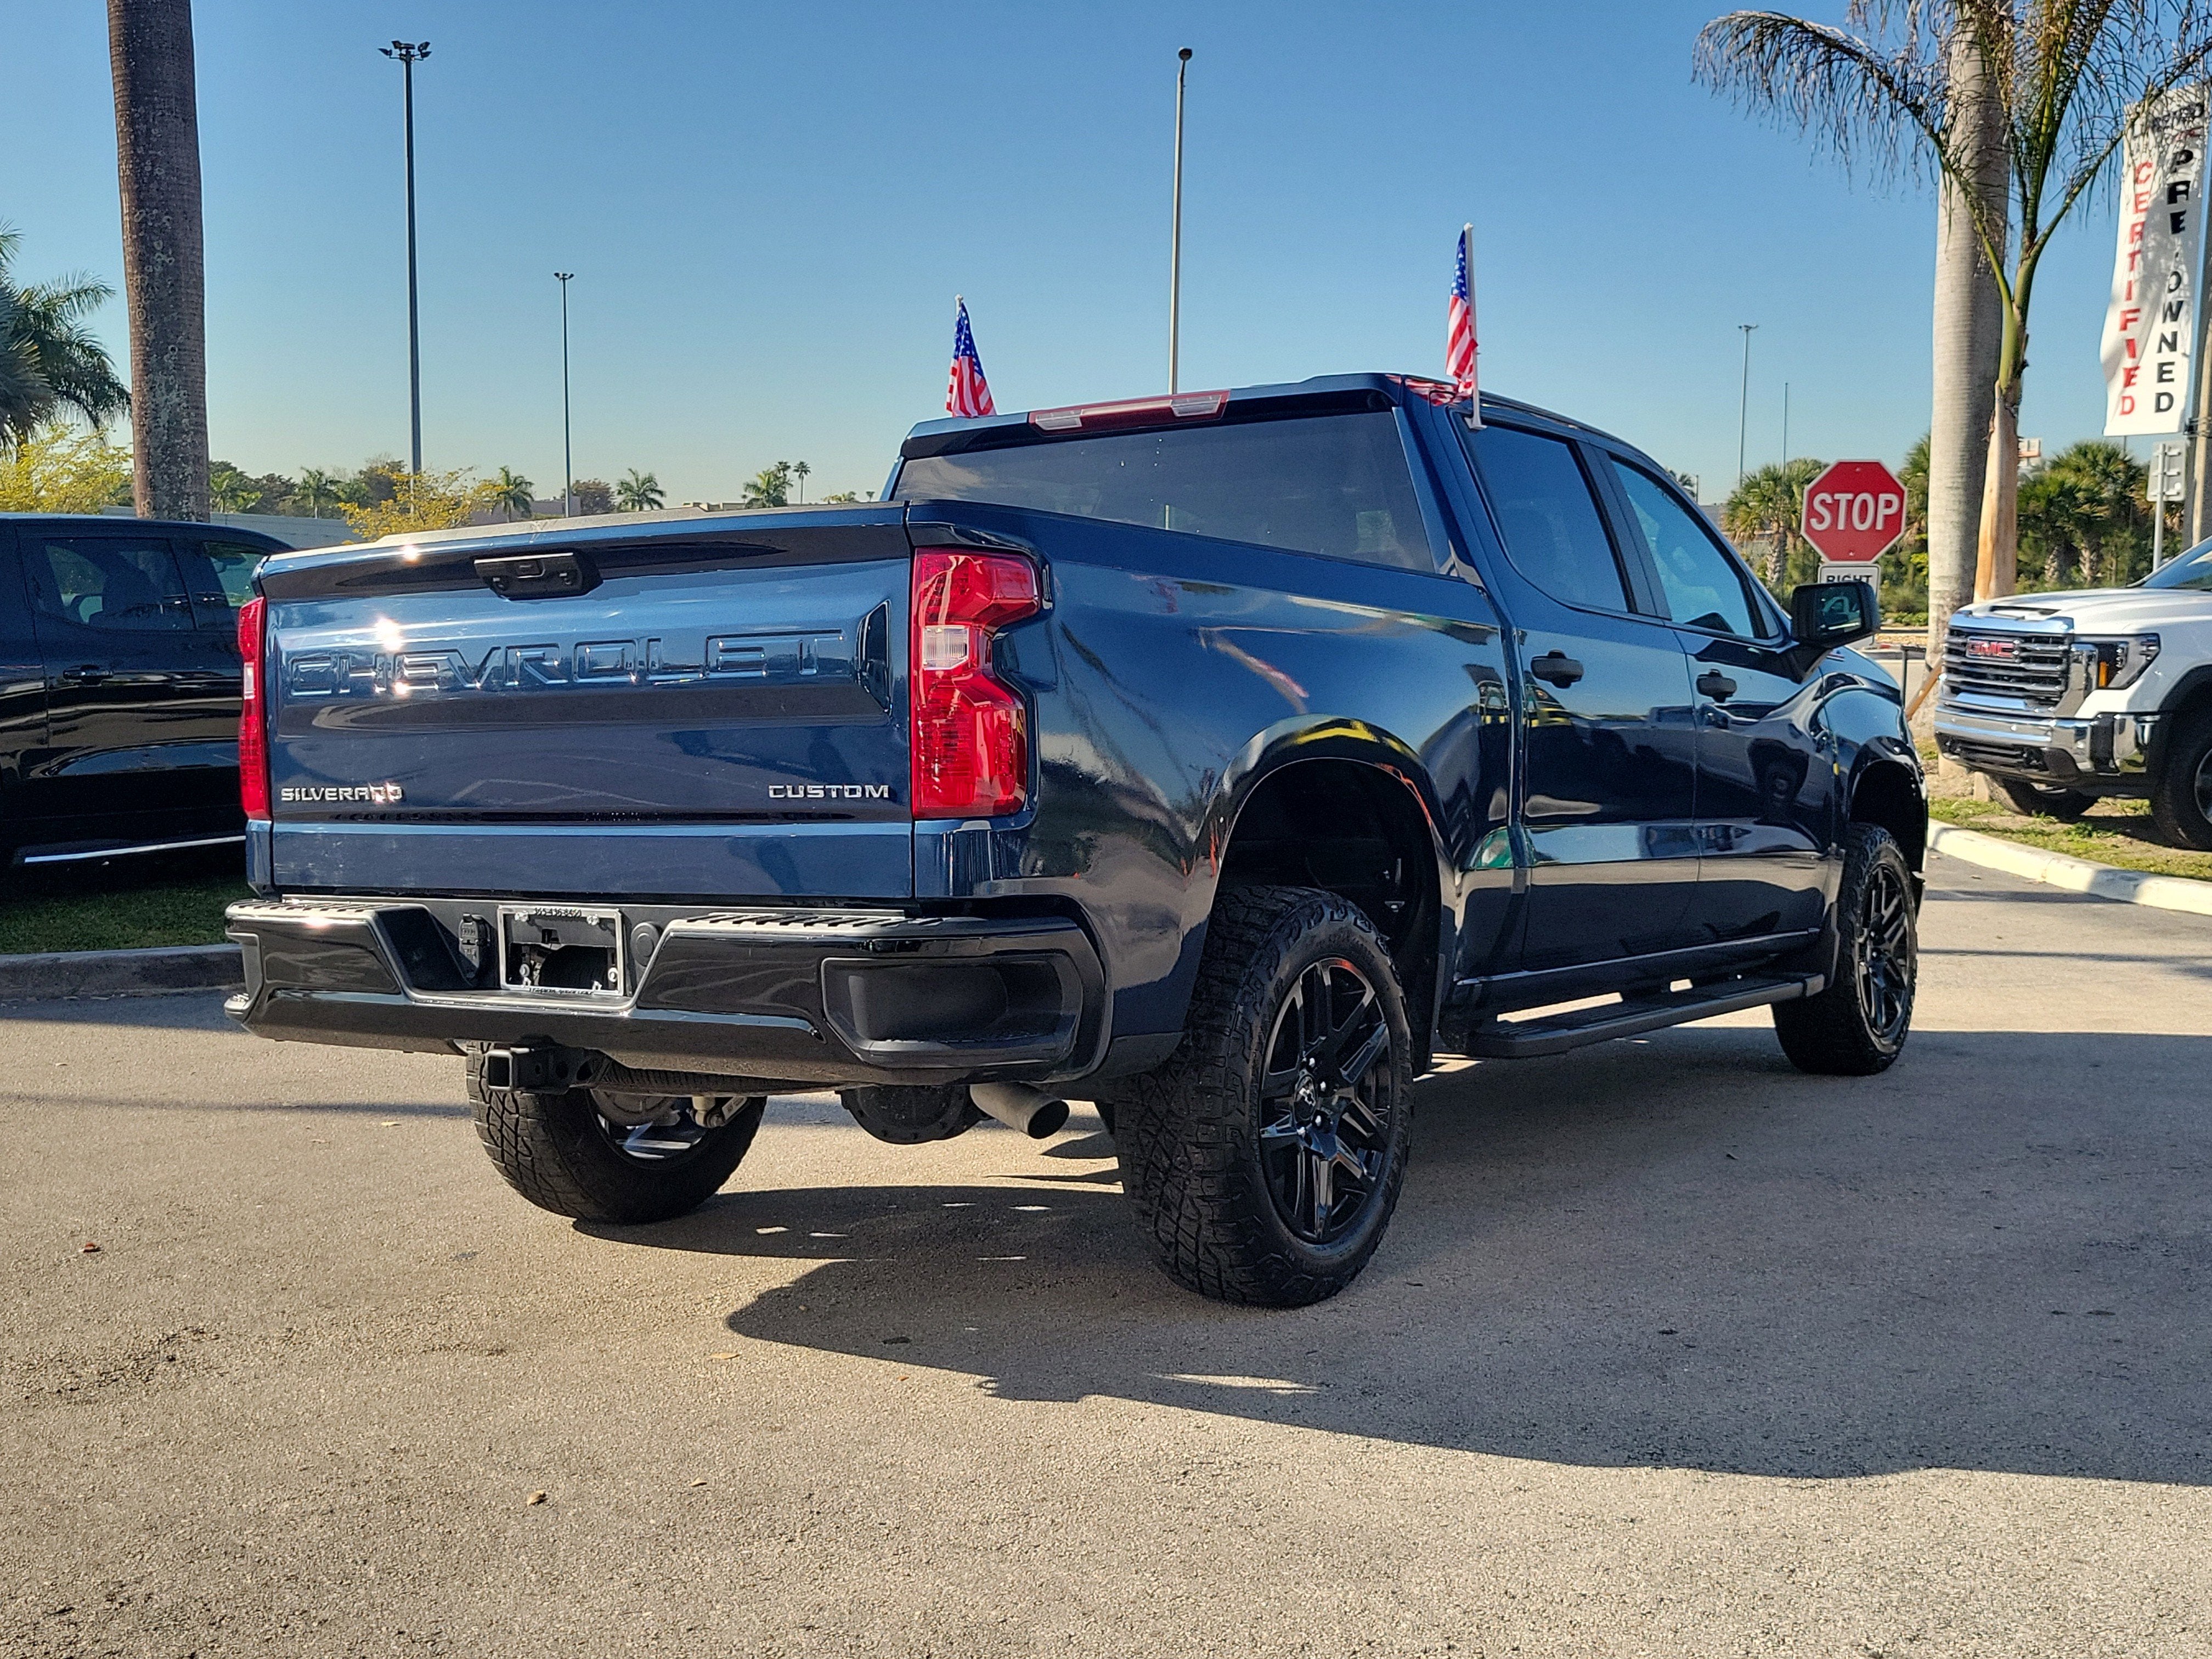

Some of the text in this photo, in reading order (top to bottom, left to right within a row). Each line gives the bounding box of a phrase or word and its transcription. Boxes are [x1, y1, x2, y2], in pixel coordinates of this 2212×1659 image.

[2119, 161, 2153, 415] CERTIFIED
[1809, 492, 1900, 531] STOP
[289, 629, 845, 696] CHEVROLET
[1967, 640, 2015, 658] GMC
[280, 785, 405, 802] SILVERADO
[769, 785, 889, 799] CUSTOM
